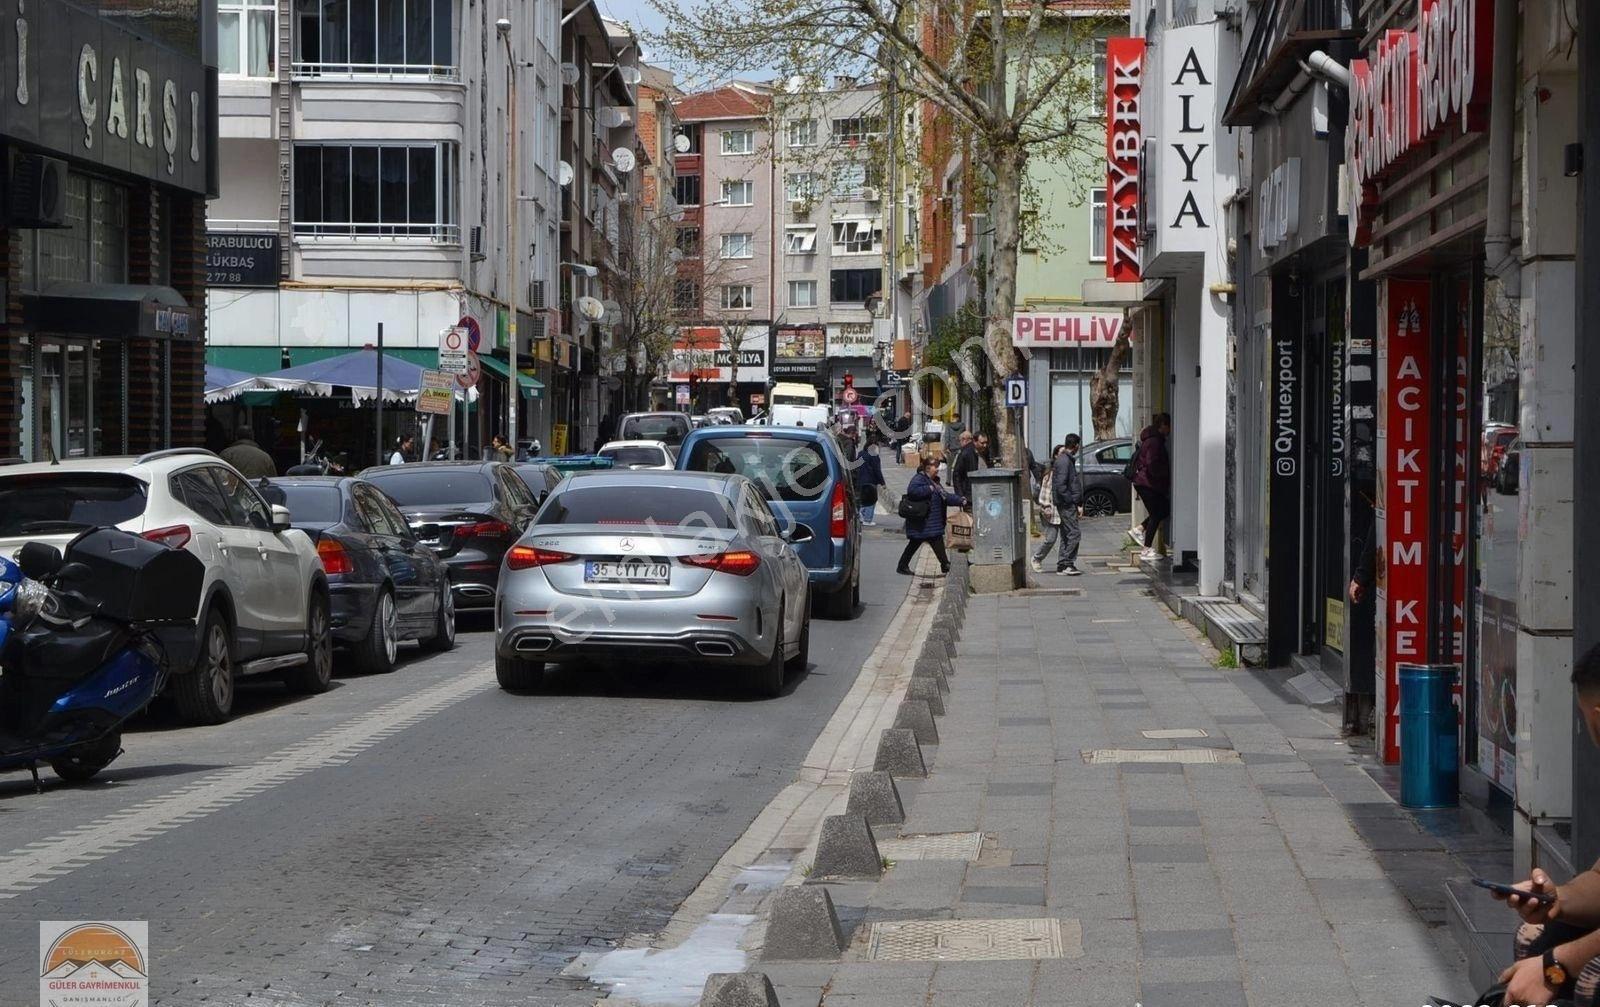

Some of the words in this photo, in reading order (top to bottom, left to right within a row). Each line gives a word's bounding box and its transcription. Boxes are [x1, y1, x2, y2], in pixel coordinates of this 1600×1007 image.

[78, 43, 200, 176] ÇARŞI
[1108, 54, 1142, 279] ZEYBEK
[1169, 46, 1212, 229] ALYA
[1016, 316, 1136, 341] PEHLİV
[1012, 385, 1022, 401] D
[1275, 339, 1297, 453] Qytuexport
[1392, 356, 1422, 566] ACIKTIM
[592, 563, 609, 576] 35
[643, 564, 668, 578] 740
